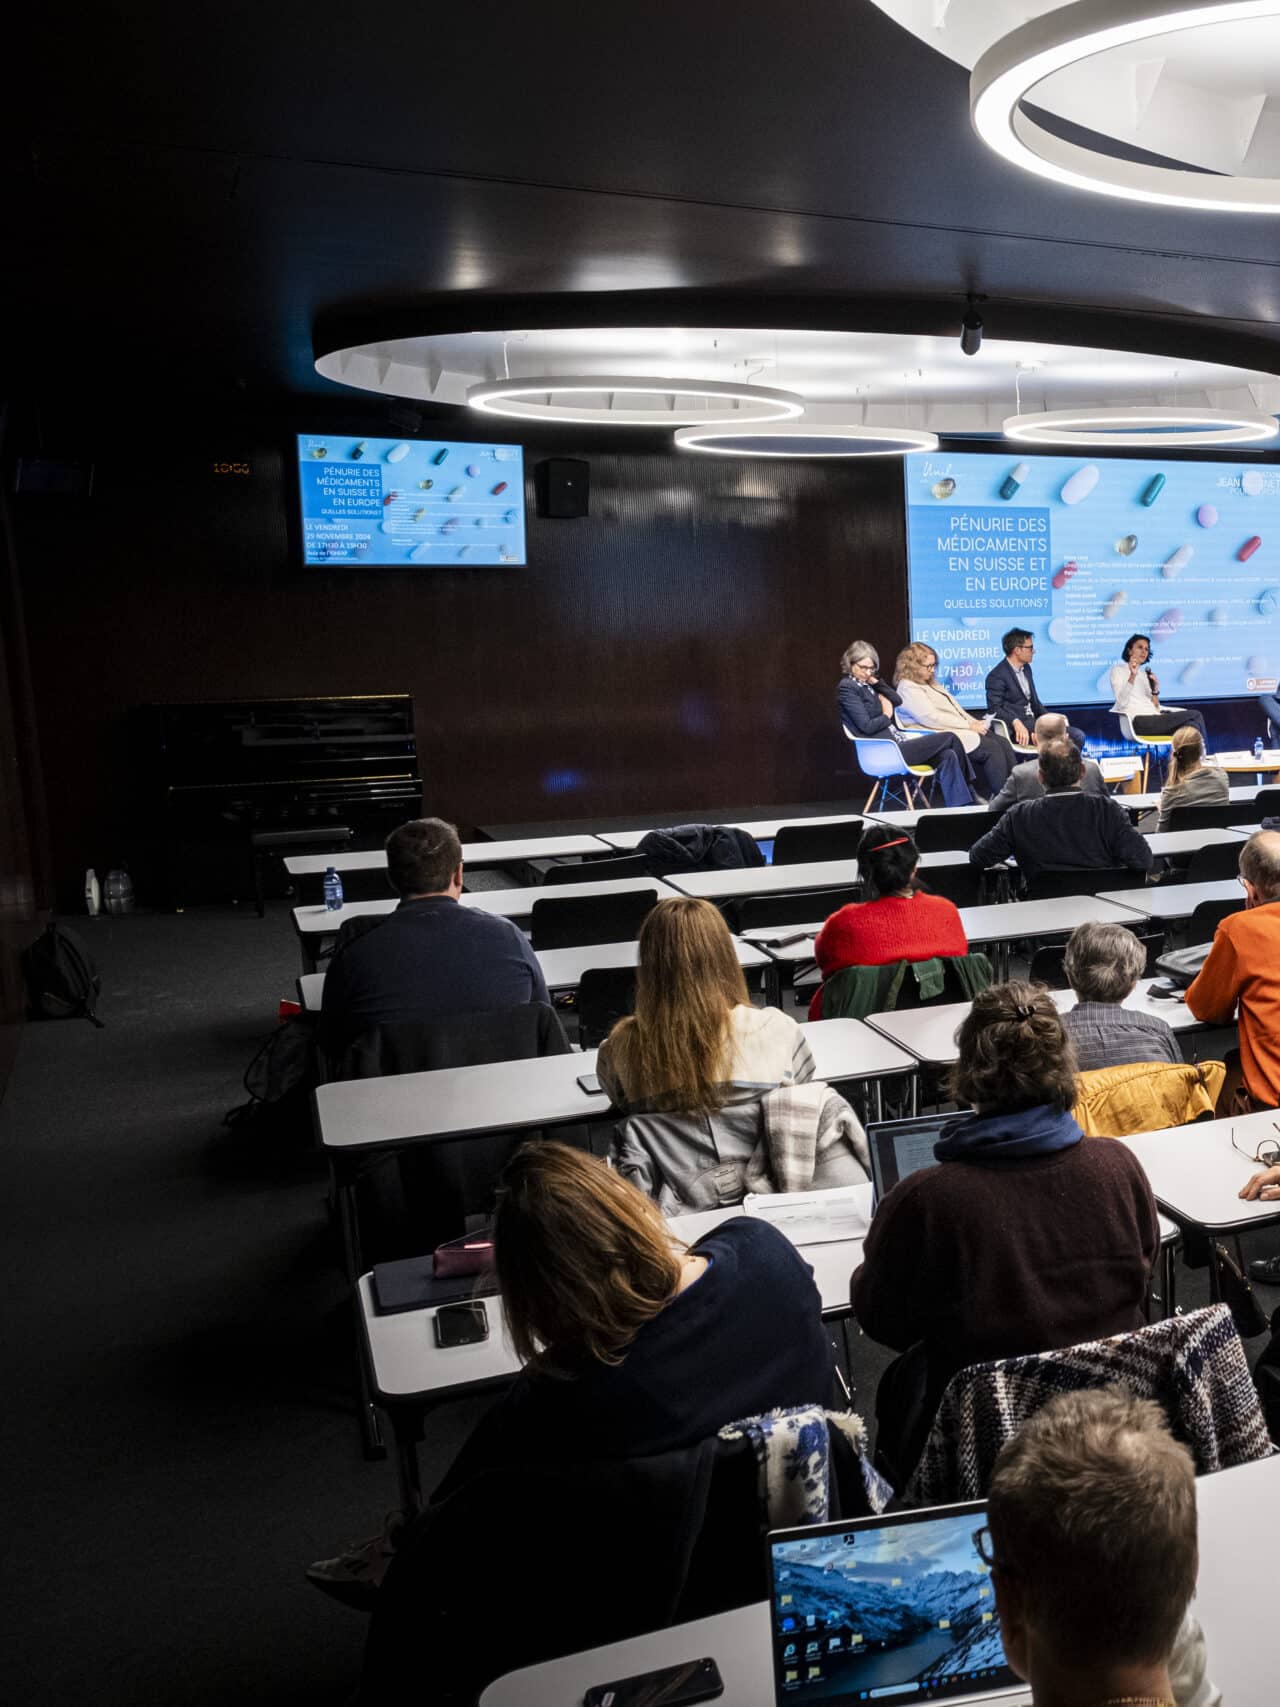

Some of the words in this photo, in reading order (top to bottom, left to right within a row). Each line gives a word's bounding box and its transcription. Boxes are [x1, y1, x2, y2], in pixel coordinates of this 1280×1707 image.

[324, 466, 361, 477] PÉNURIE
[362, 468, 380, 477] DES
[316, 476, 380, 487] MÉDICAMENTS
[323, 487, 336, 496] EN
[337, 487, 368, 497] SUISSE
[369, 488, 380, 497] ET
[333, 497, 345, 507] EN
[347, 497, 381, 507] EUROPE
[950, 513, 1014, 532] PÉNURIE
[1018, 518, 1047, 532] DES
[937, 534, 1047, 552] MÉDICAMENTS
[949, 557, 969, 571] EN
[973, 557, 1025, 572] SUISSE
[1029, 557, 1048, 571] ET
[965, 577, 986, 591] EN
[990, 577, 1048, 591] EUROPE
[944, 599, 987, 609] QUELLES
[989, 598, 1049, 609] SOLUTIONS?
[916, 631, 929, 641] LE
[932, 629, 990, 641] VENDREDI
[936, 647, 1000, 659] NOVEMBRE
[937, 664, 973, 678] 17H30
[976, 662, 985, 676] À
